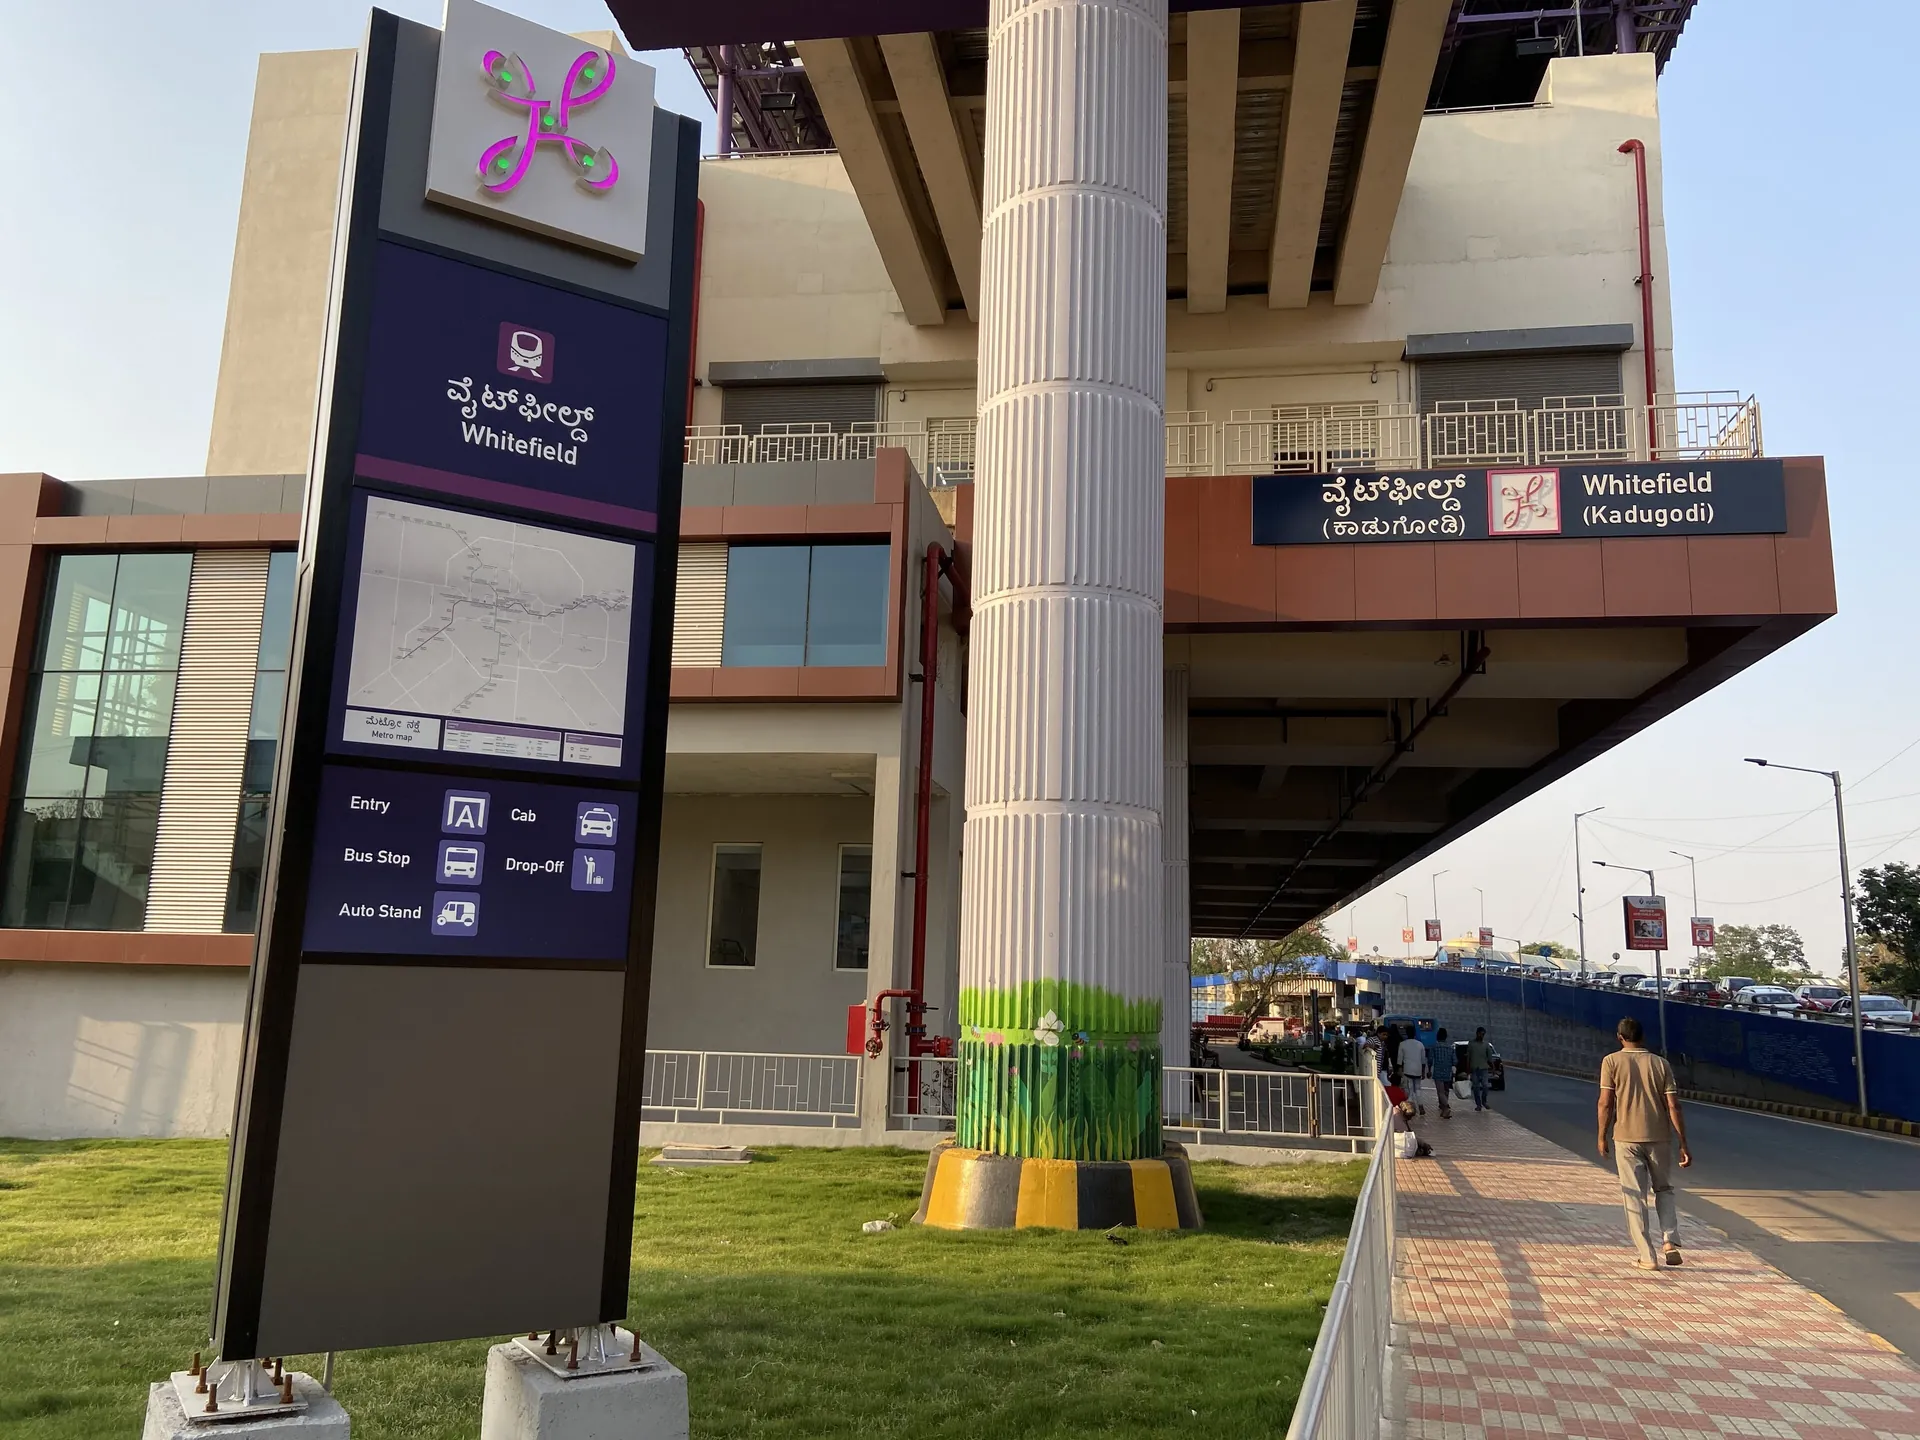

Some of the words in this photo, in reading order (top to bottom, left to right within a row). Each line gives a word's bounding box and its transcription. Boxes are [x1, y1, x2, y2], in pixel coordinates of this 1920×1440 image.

[461, 421, 578, 466] Whitefield
[1582, 471, 1712, 496] Whitefield
[1583, 502, 1714, 527] (Kadugodi)
[1322, 514, 1466, 539] (ಕಾಡುಗೋಡಿ)
[371, 730, 394, 740] Metro
[396, 733, 413, 743] map
[350, 795, 391, 815] Entry
[511, 808, 537, 822] Cab
[344, 848, 373, 863] Bus
[376, 850, 411, 867] Stop
[505, 857, 565, 875] Drop-Off
[338, 902, 375, 917] Auto
[378, 904, 422, 919] Stand
